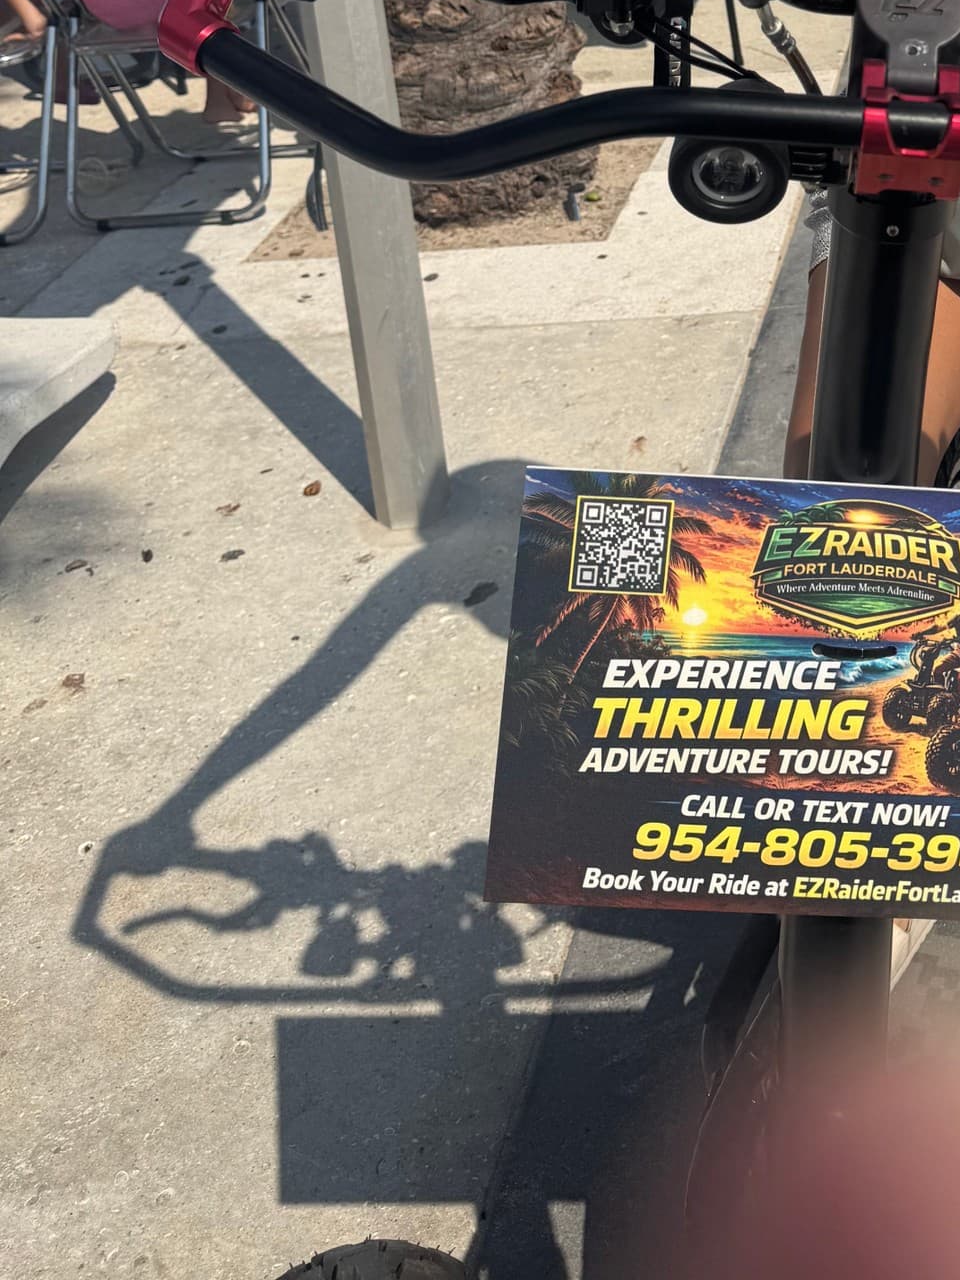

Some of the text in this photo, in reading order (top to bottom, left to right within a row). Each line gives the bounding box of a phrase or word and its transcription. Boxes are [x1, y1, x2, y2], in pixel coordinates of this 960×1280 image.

[784, 563, 937, 586] FORT LAUDERDALE
[776, 582, 936, 603] Where Adventure Meets Adrenaline
[602, 658, 842, 691] EXPERIENCE
[592, 696, 869, 741] THRILLING
[578, 747, 893, 775] ADVENTURE TOURS!
[681, 794, 950, 828] CALL OR TEXT NOW!
[582, 867, 646, 892] Book
[650, 870, 704, 894] Your
[708, 872, 760, 896] Ride
[764, 881, 789, 898] at
